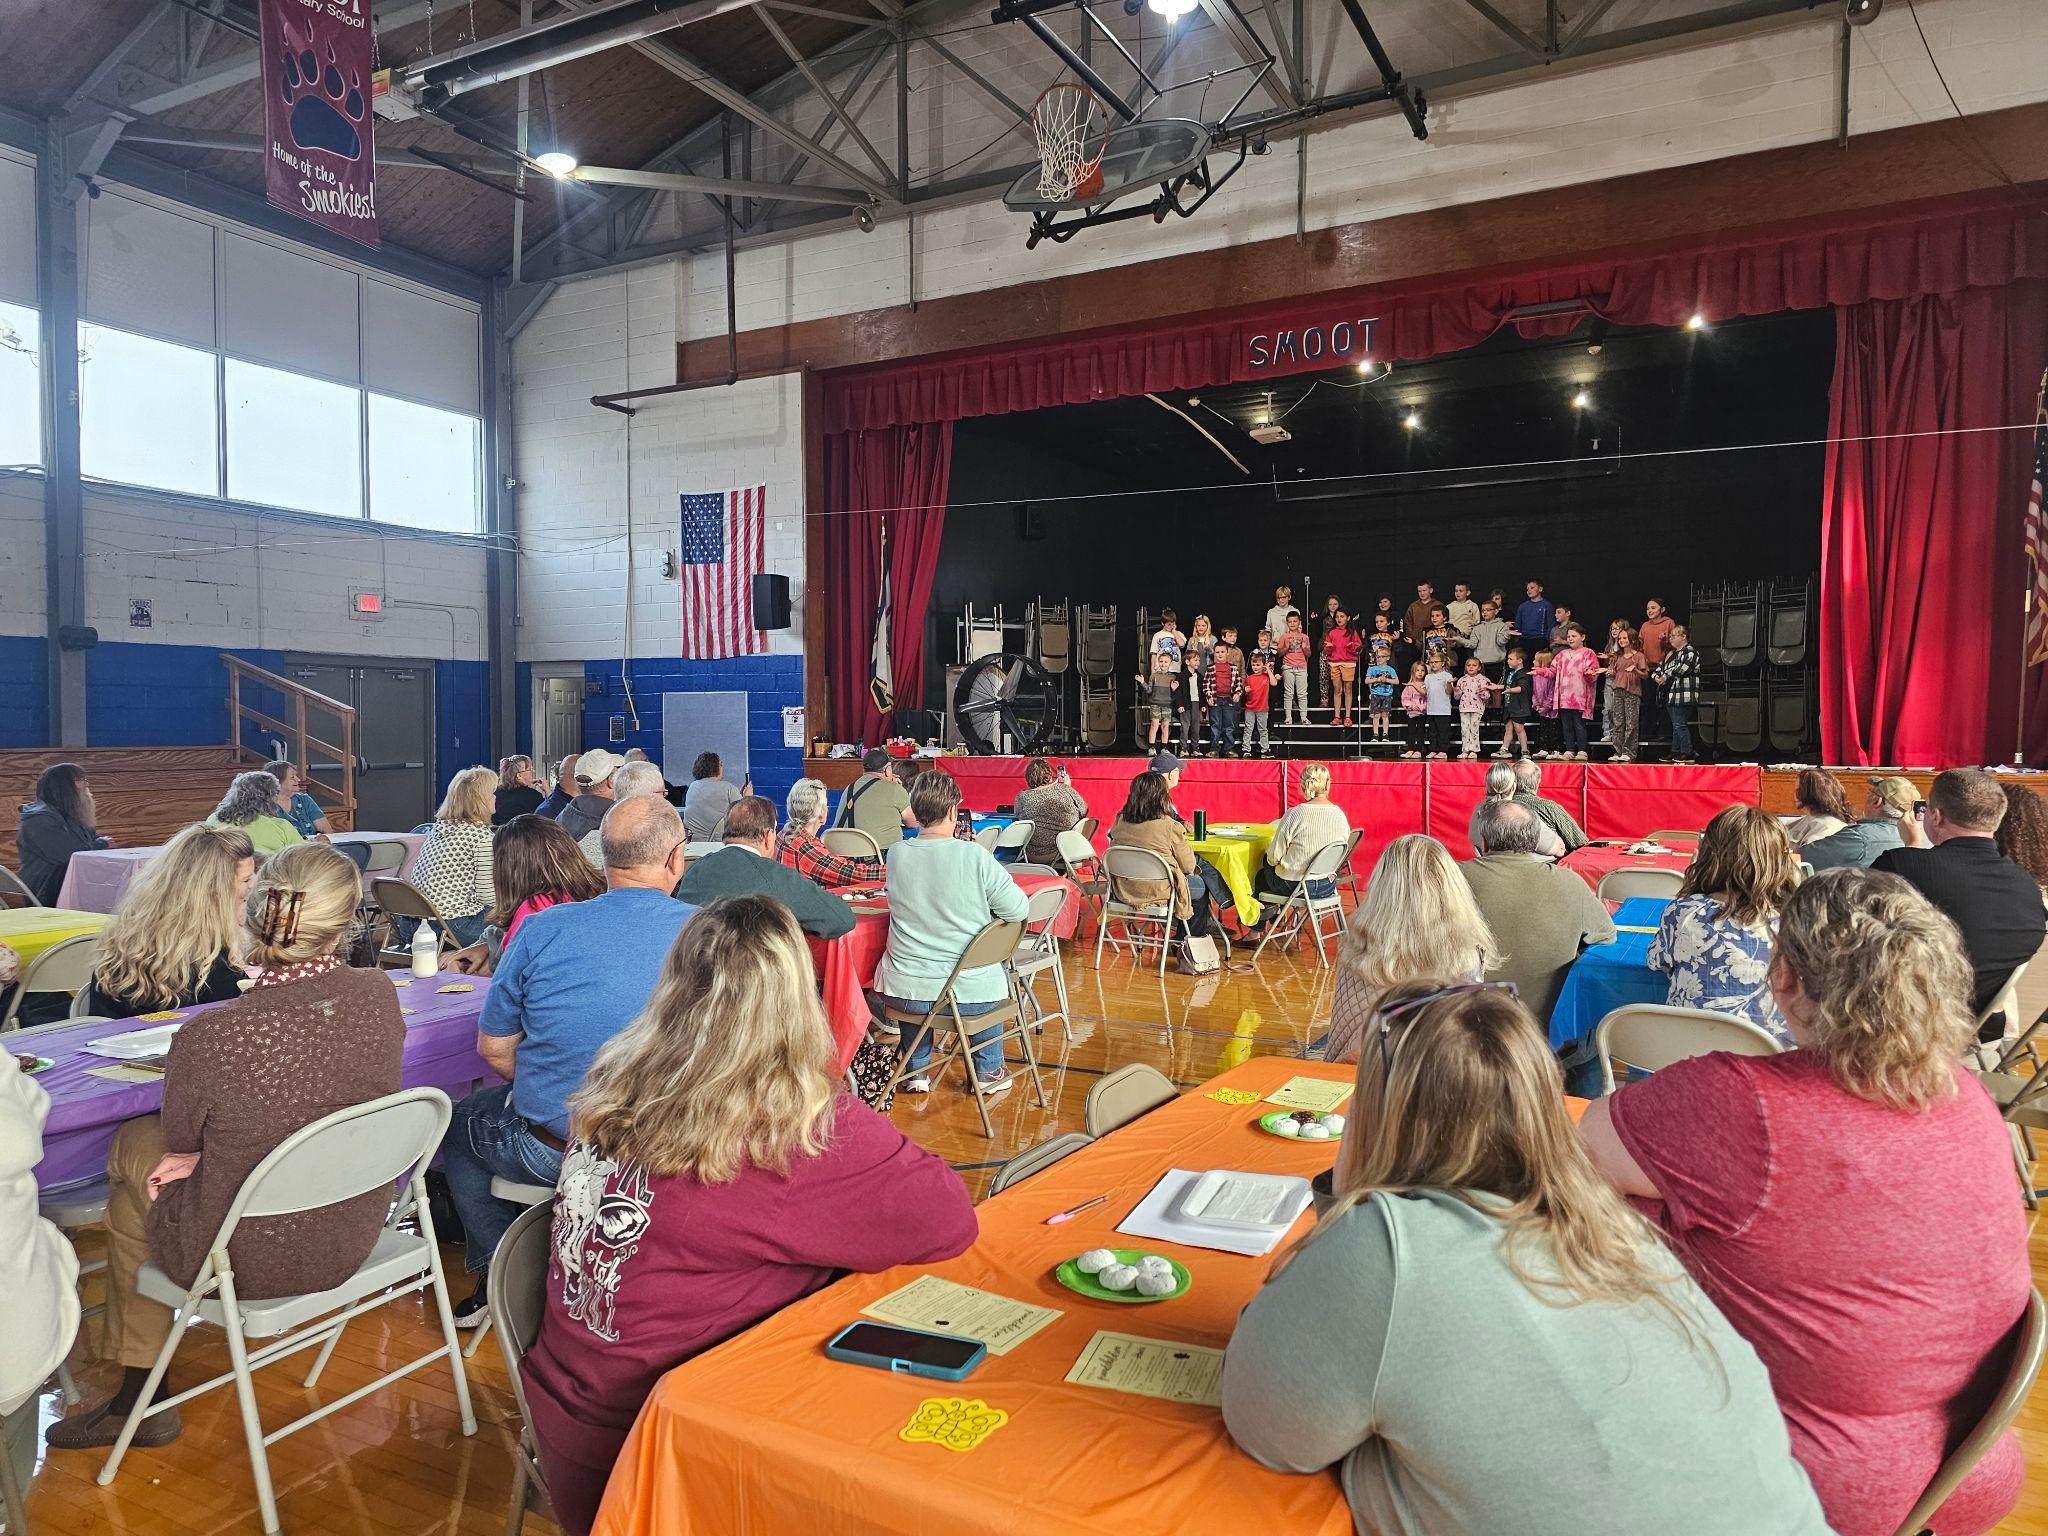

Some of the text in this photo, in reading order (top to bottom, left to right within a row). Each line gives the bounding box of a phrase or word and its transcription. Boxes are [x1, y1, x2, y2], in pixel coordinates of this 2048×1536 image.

[326, 4, 365, 29] School
[272, 140, 337, 186] Home of the
[298, 180, 376, 220] Smokies!
[1249, 317, 1381, 369] SMOOT
